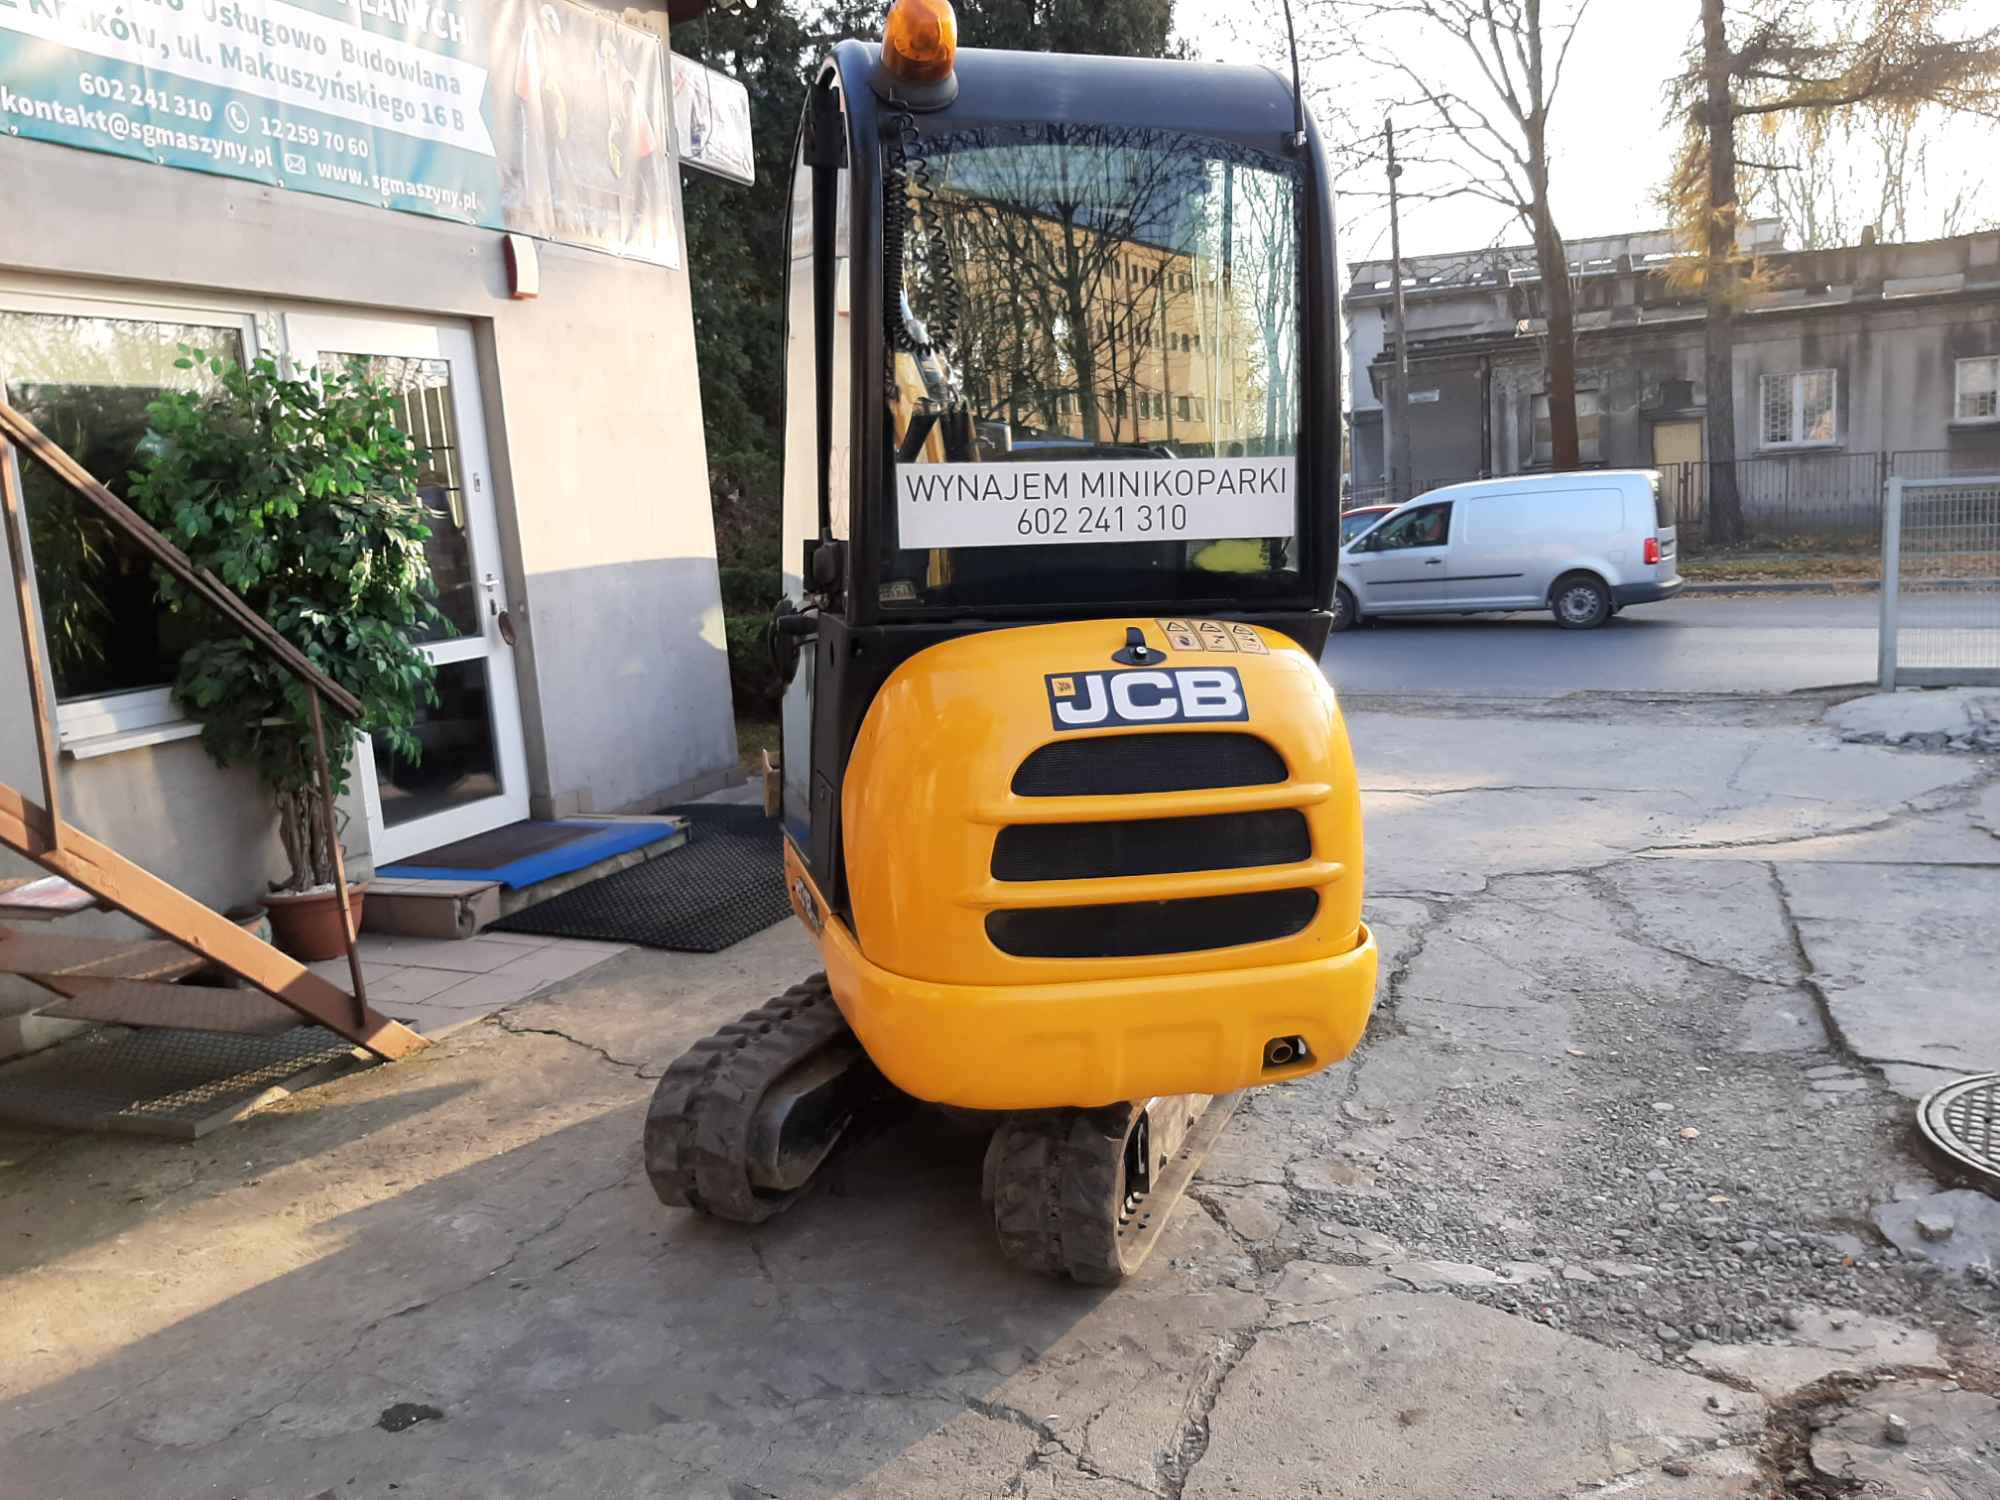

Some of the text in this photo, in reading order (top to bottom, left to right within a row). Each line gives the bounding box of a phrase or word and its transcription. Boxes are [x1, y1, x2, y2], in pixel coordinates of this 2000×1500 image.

[177, 34, 212, 64] ul.
[219, 43, 415, 122] Makuszyńskiego
[421, 102, 447, 127] 16
[452, 108, 464, 132] B
[341, 38, 461, 94] Budowlana
[1, 85, 273, 168] kontakt@sgmaszyny.pl
[79, 71, 369, 158] 602 241 310 12 259 70 60
[906, 467, 1286, 502] WYNAJEM MINIKOPARKI
[1017, 504, 1186, 535] 602 241 310
[1055, 671, 1243, 724] JCB
